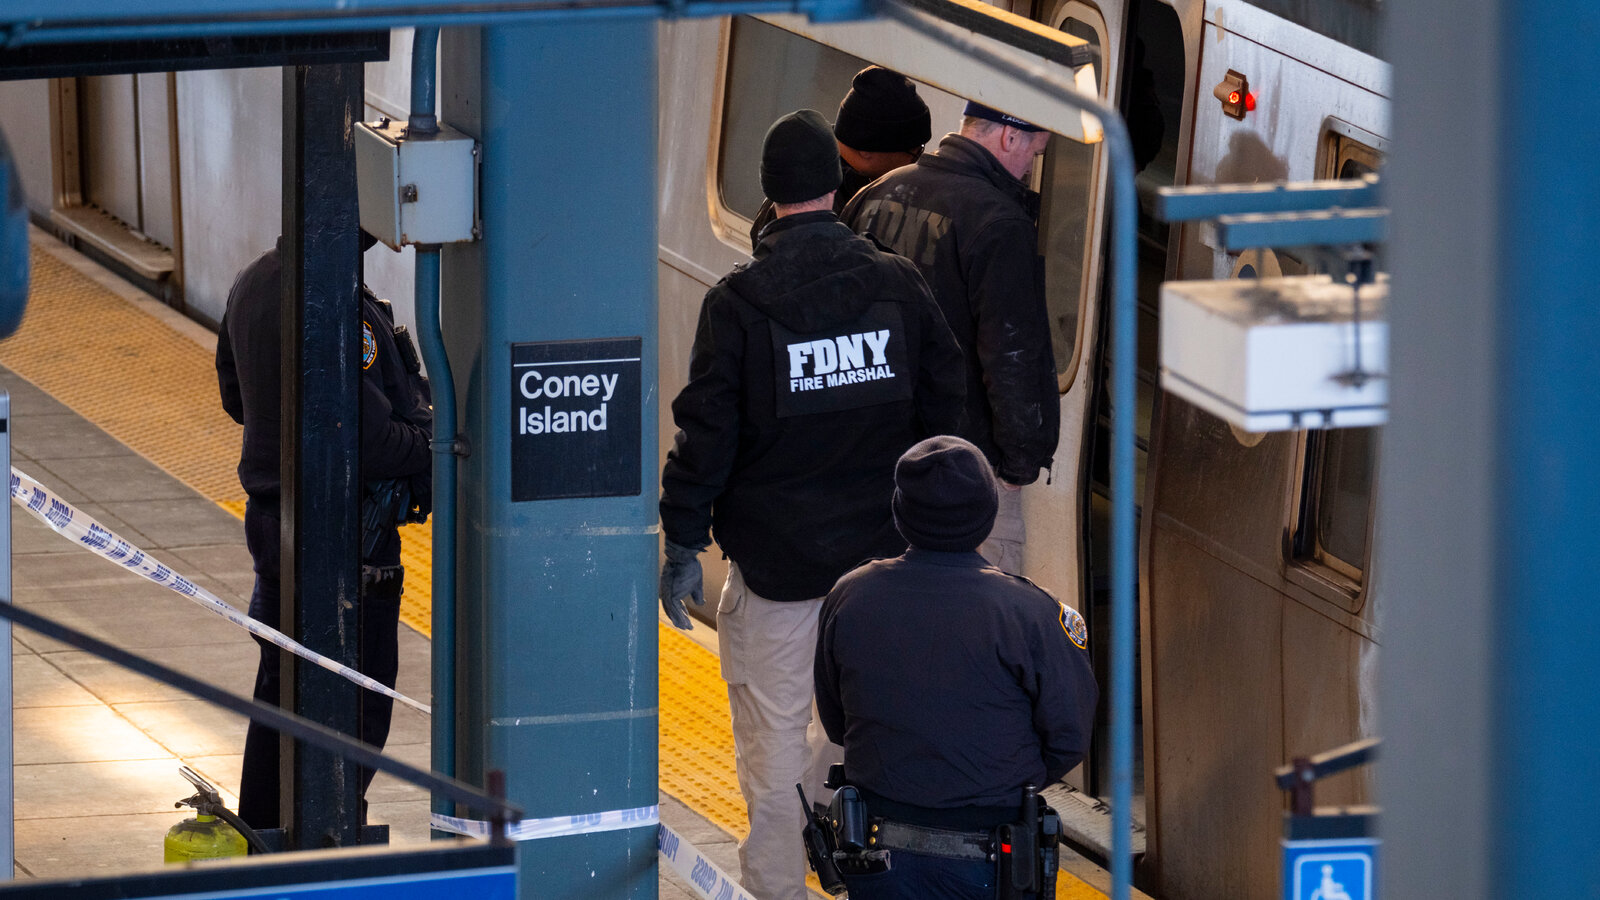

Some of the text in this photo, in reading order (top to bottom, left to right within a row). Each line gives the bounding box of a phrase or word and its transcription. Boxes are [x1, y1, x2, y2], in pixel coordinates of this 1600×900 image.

[853, 200, 953, 266] FDNY
[787, 329, 890, 378] FDNY
[519, 370, 619, 401] Coney
[790, 365, 895, 393] FIRE MARSHAL
[519, 402, 607, 435] Island
